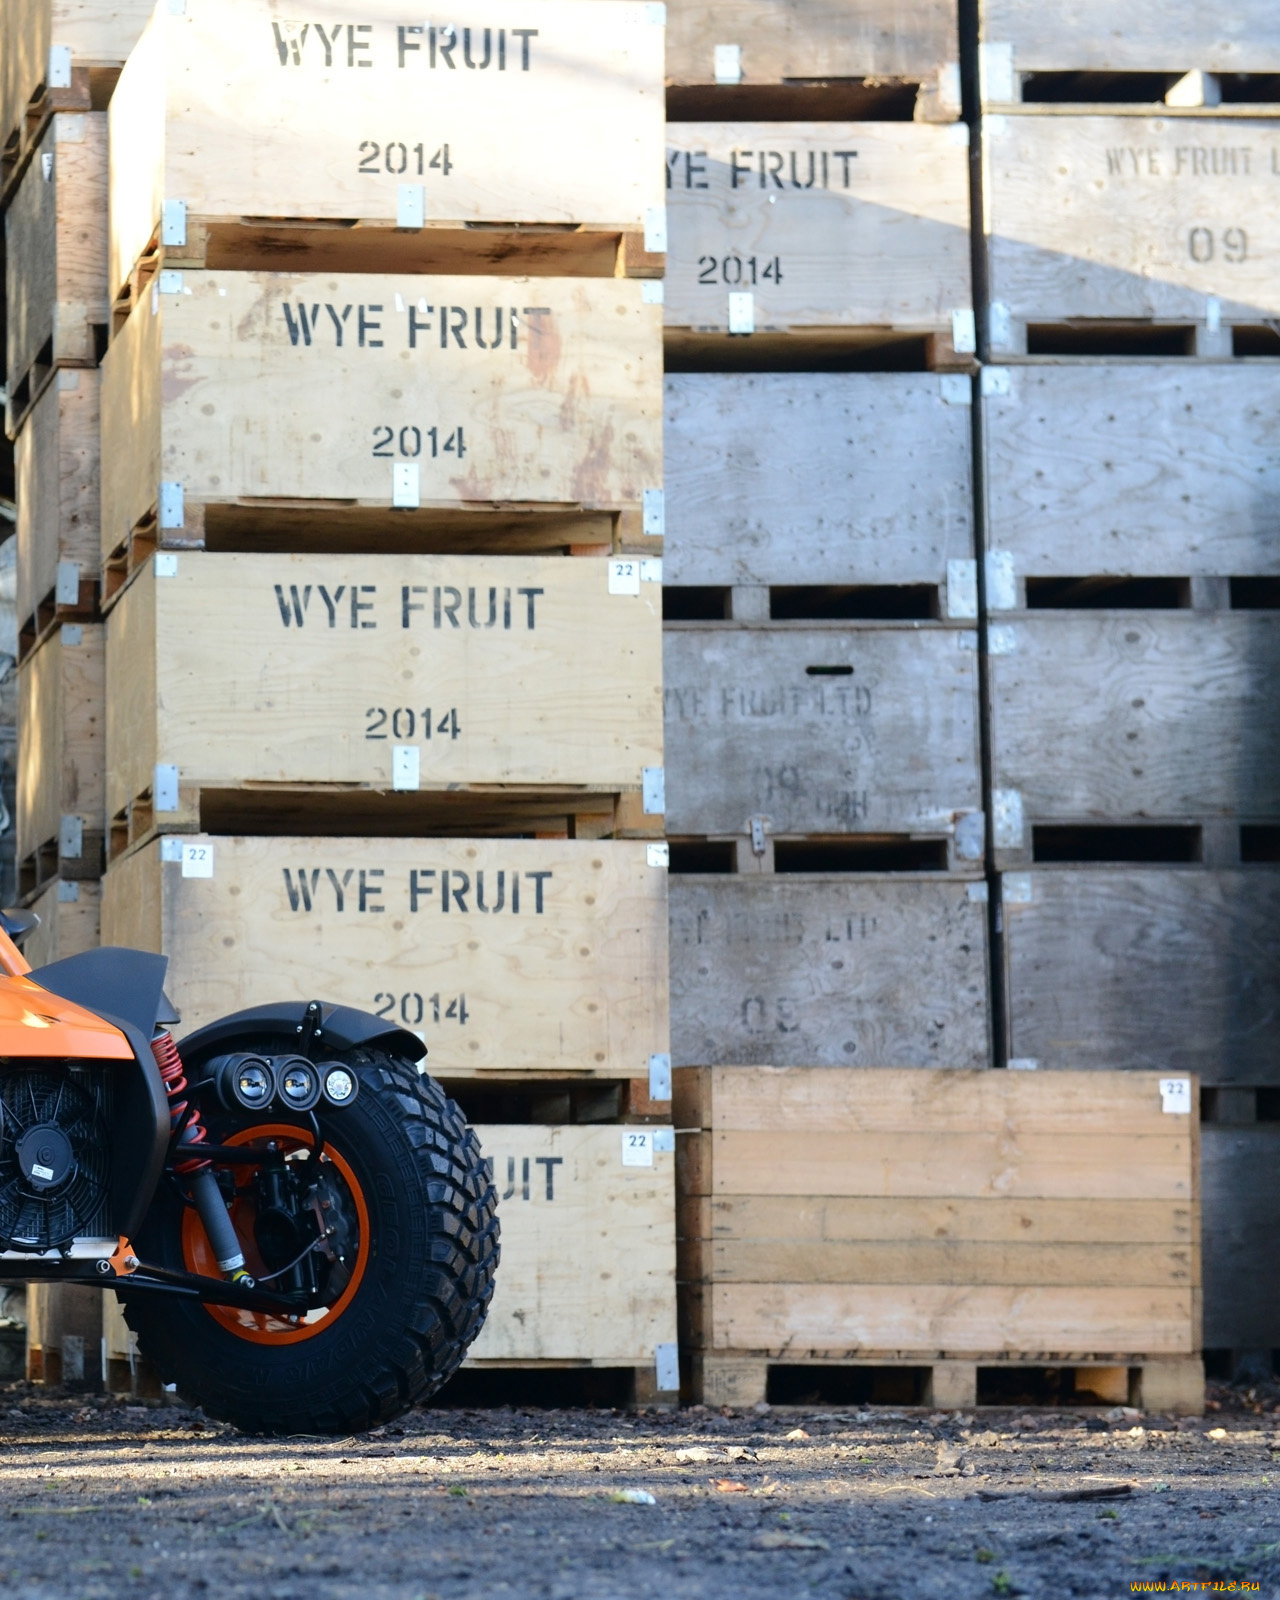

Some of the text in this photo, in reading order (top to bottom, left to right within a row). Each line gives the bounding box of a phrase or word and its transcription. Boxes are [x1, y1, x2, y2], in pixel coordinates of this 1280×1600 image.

[271, 22, 539, 72] WYE FRUIT
[357, 140, 453, 177] 2014
[666, 150, 858, 190] YE FRUIT
[1105, 146, 1160, 176] WYE
[1173, 146, 1252, 176] FRUIT
[1187, 226, 1249, 264] 09
[698, 256, 783, 285] 2014
[282, 302, 551, 350] WYE FRUIT
[372, 425, 467, 459] 2014
[615, 563, 633, 576] 22
[273, 584, 545, 630] WYE FRUIT
[365, 707, 462, 740] 2014
[189, 848, 207, 861] 22
[282, 867, 553, 914] WYE FRUIT
[373, 992, 470, 1025] 2014
[1167, 1082, 1184, 1094] 22
[628, 1134, 647, 1147] 22
[488, 1156, 563, 1201] UIT
